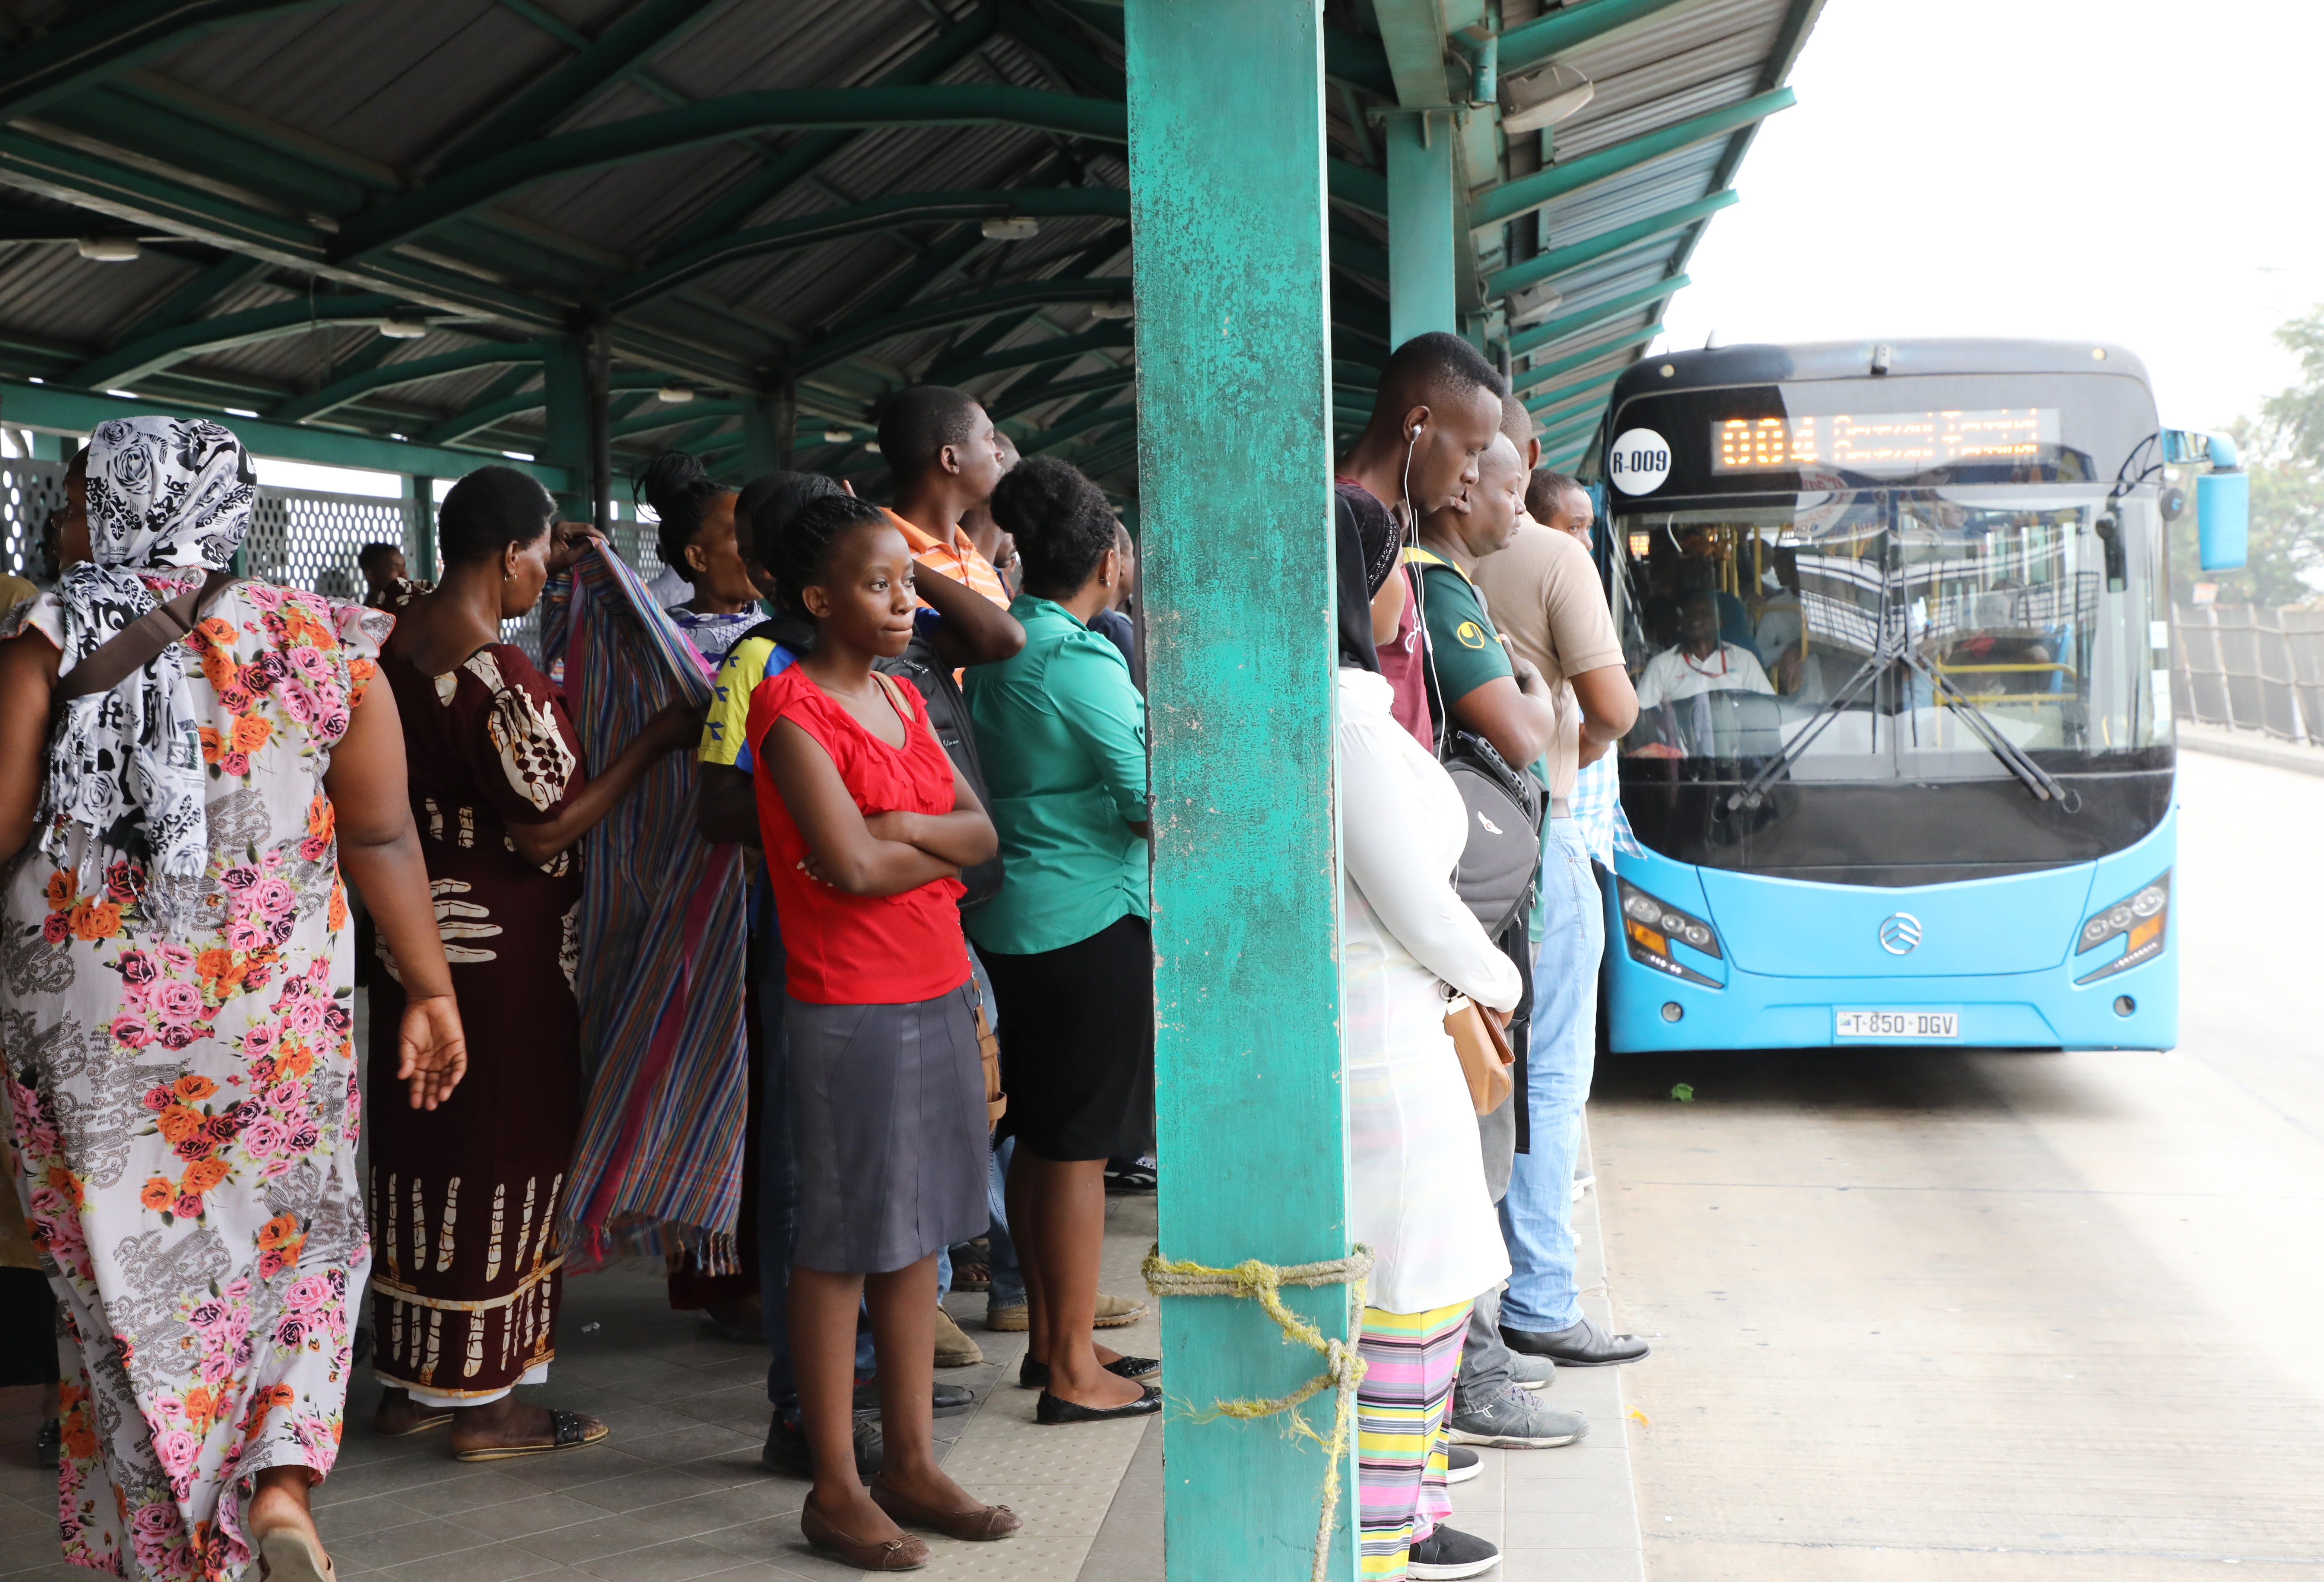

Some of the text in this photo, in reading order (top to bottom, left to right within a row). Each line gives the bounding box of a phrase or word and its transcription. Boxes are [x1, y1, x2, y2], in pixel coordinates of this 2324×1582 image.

[1613, 449, 1667, 474] R-009
[1870, 1015, 1904, 1033] 850
[1918, 1016, 1953, 1034] DGV
